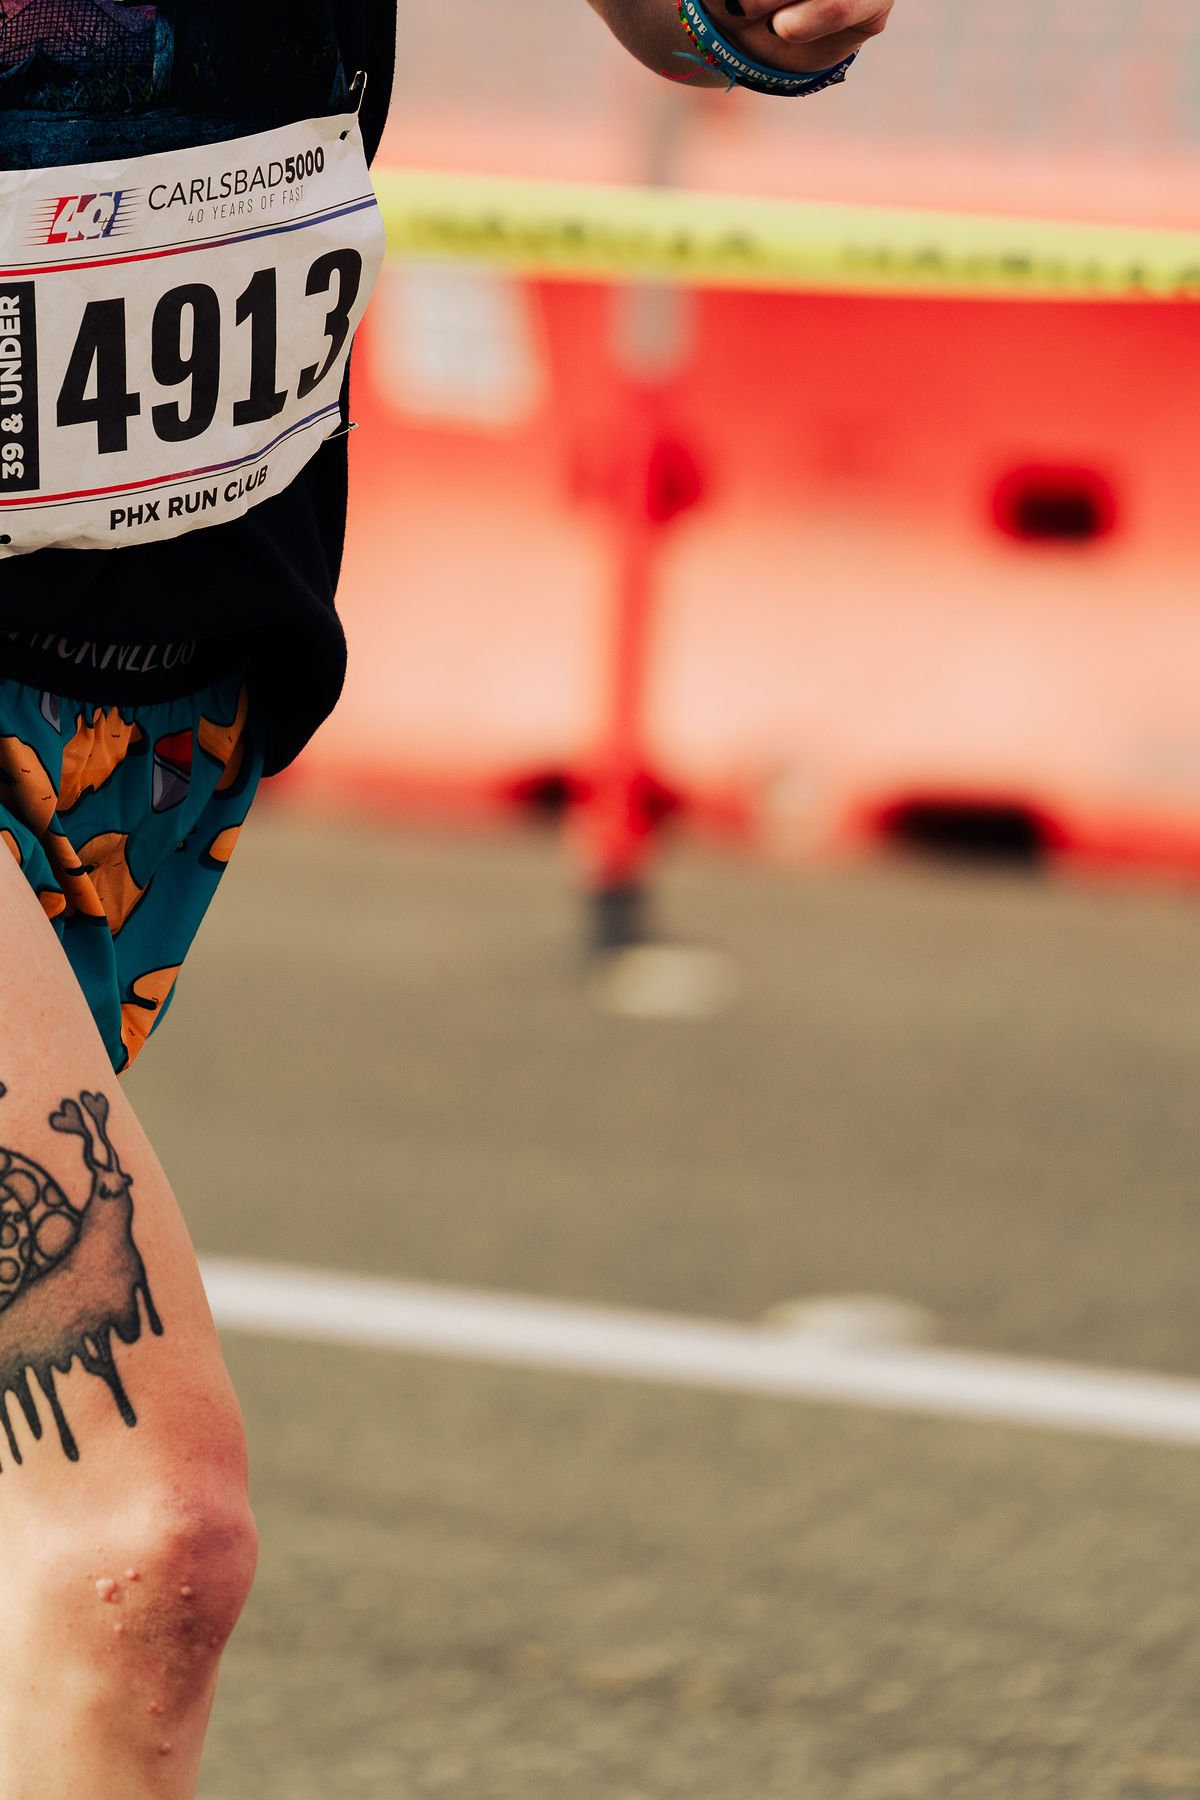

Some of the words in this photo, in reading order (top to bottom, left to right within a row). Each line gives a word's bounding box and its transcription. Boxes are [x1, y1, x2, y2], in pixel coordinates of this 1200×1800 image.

[147, 145, 326, 211] CARLSBAD5000
[187, 207, 204, 225] 40
[212, 199, 254, 222] YEARS
[260, 193, 276, 211] OF
[282, 185, 305, 206] FAST
[56, 247, 364, 455] 4913
[0, 412, 24, 434] &
[1, 442, 25, 480] 39
[109, 500, 161, 531] PHX
[167, 486, 218, 518] RUN
[223, 464, 269, 503] CLUB
